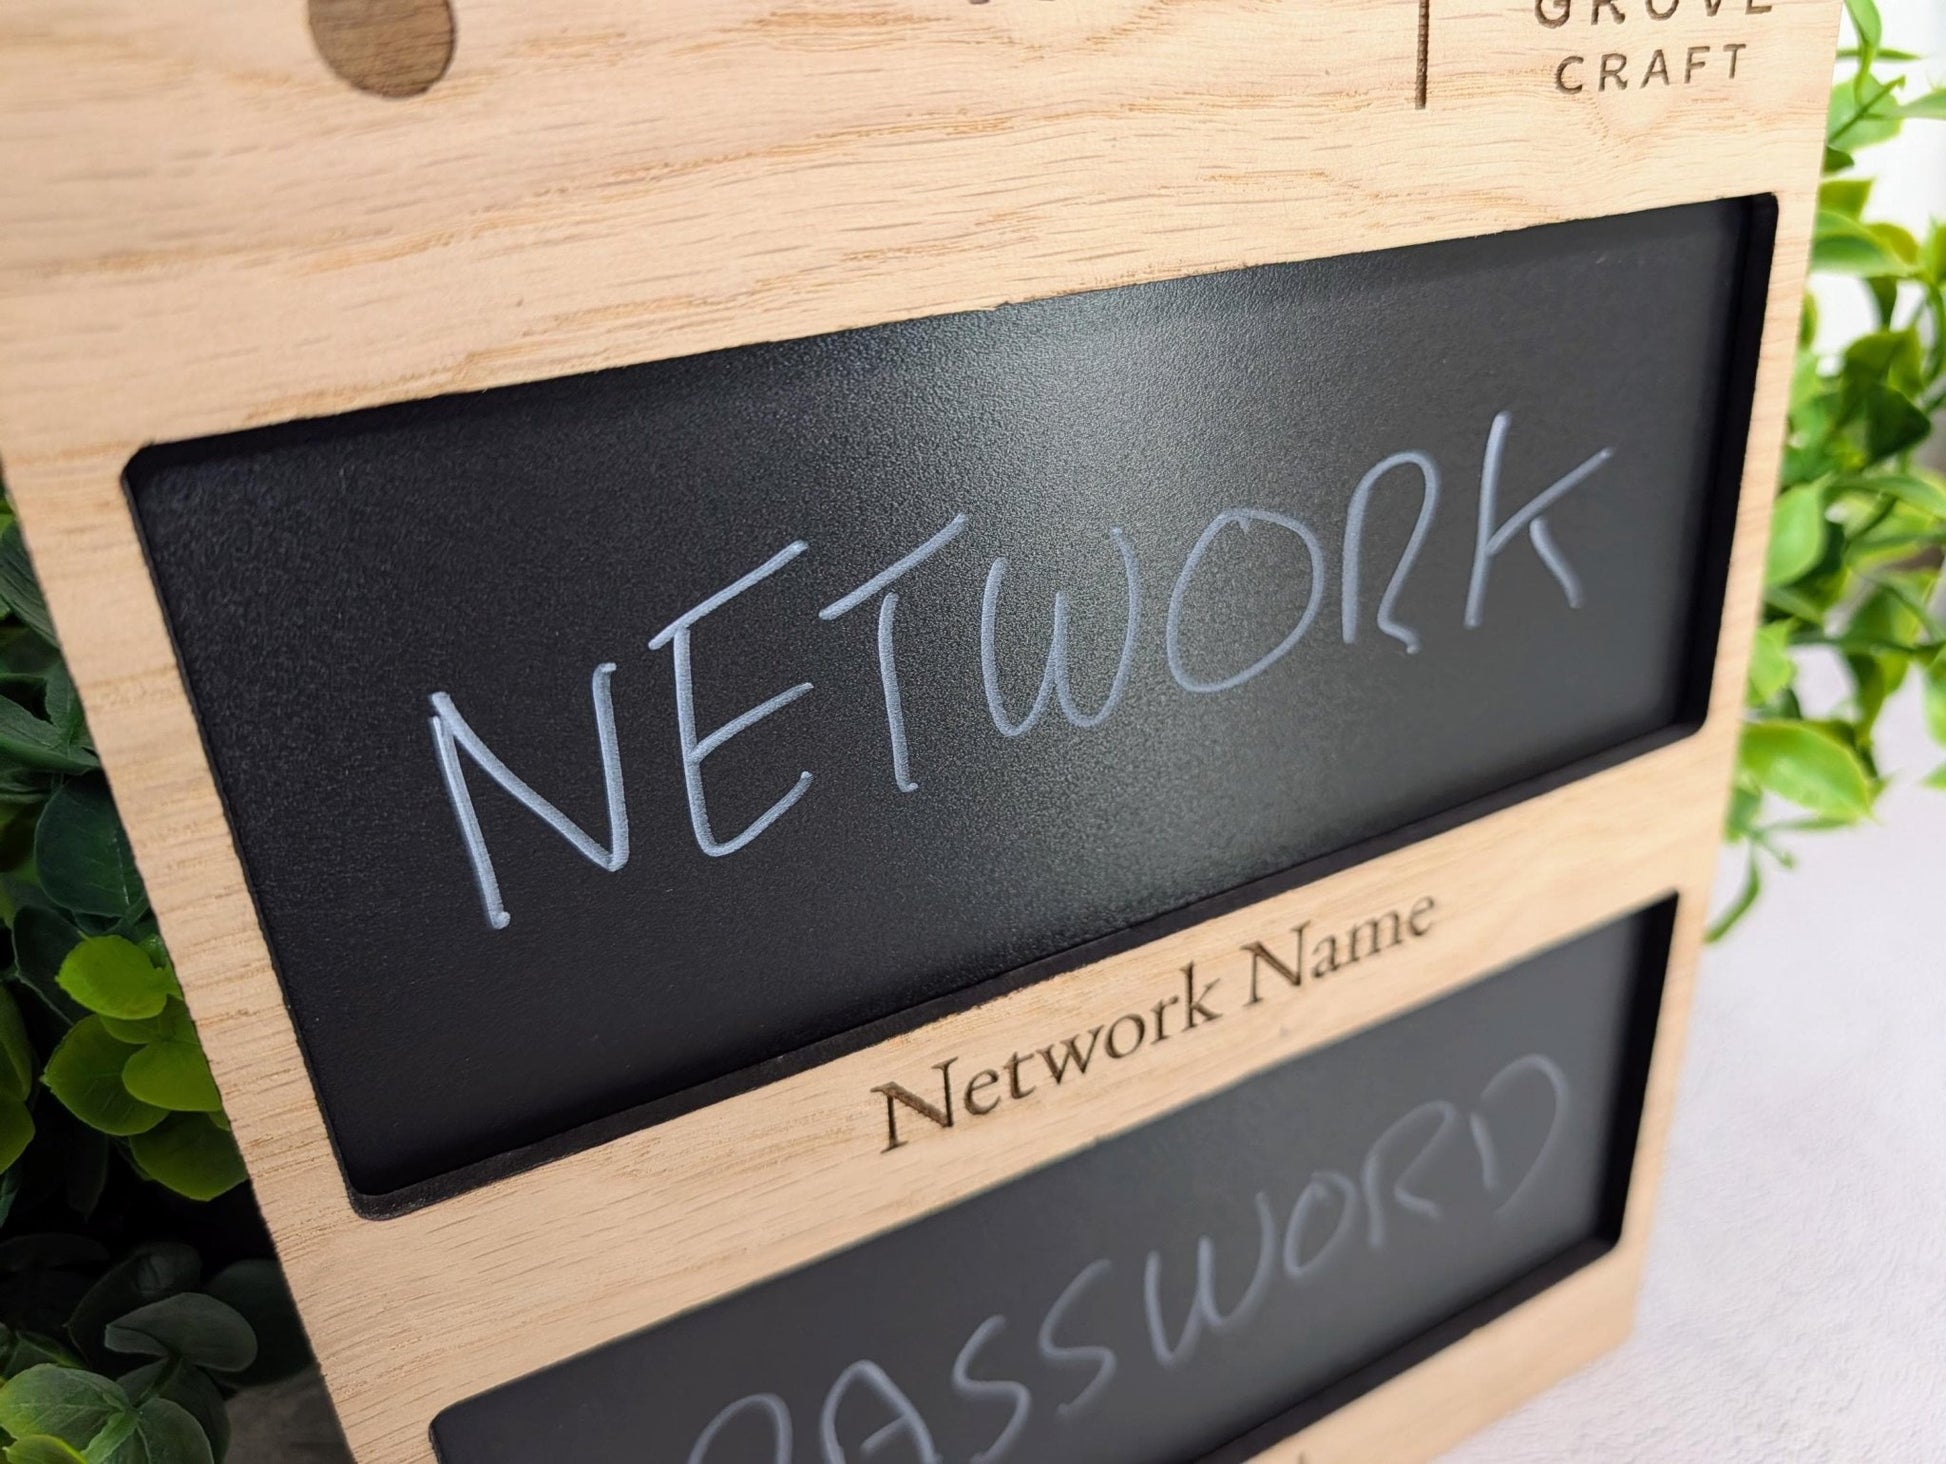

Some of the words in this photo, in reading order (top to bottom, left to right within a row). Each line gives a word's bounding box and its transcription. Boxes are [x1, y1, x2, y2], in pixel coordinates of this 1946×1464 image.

[1554, 43, 1747, 94] CRAFT
[431, 411, 1612, 930] NETWORK
[871, 960, 1224, 1153] Network
[1242, 895, 1436, 1007] Name
